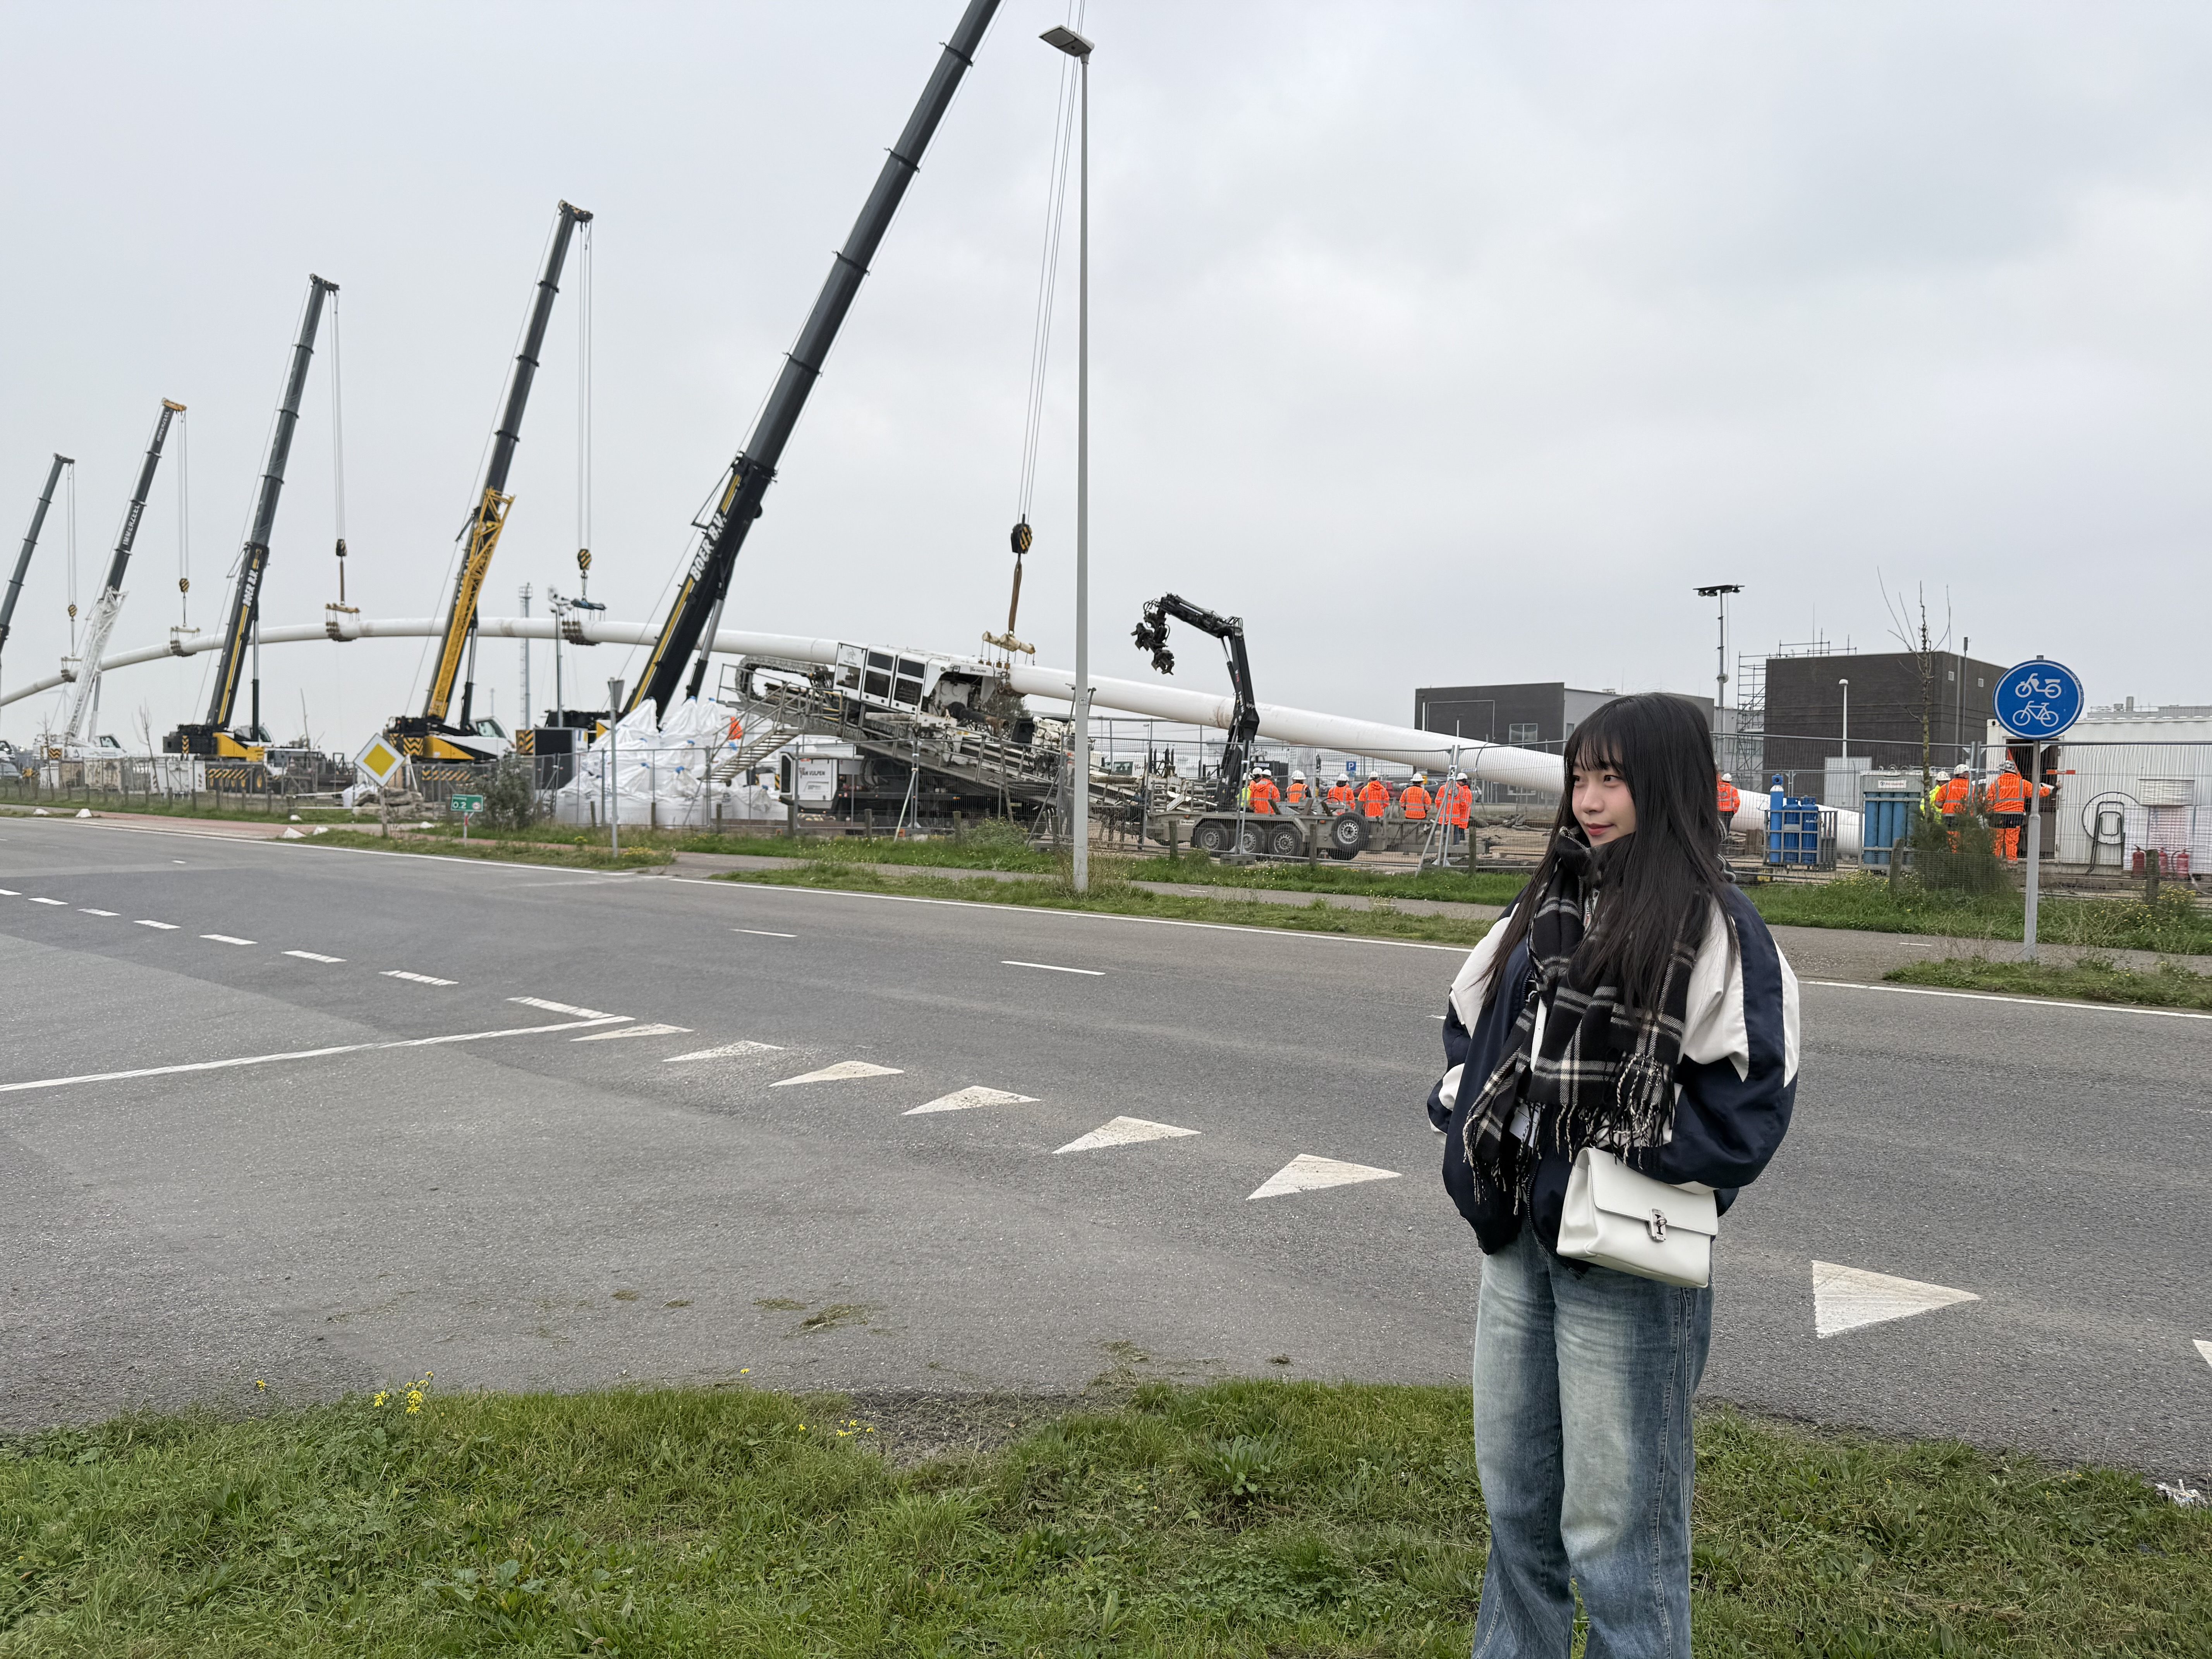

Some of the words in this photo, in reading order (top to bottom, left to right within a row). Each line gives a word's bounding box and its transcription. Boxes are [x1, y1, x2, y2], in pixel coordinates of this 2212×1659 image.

[689, 539, 714, 581] BOER
[708, 513, 727, 541] B.V.
[242, 583, 255, 607] BOER
[453, 801, 466, 809] 0.2
